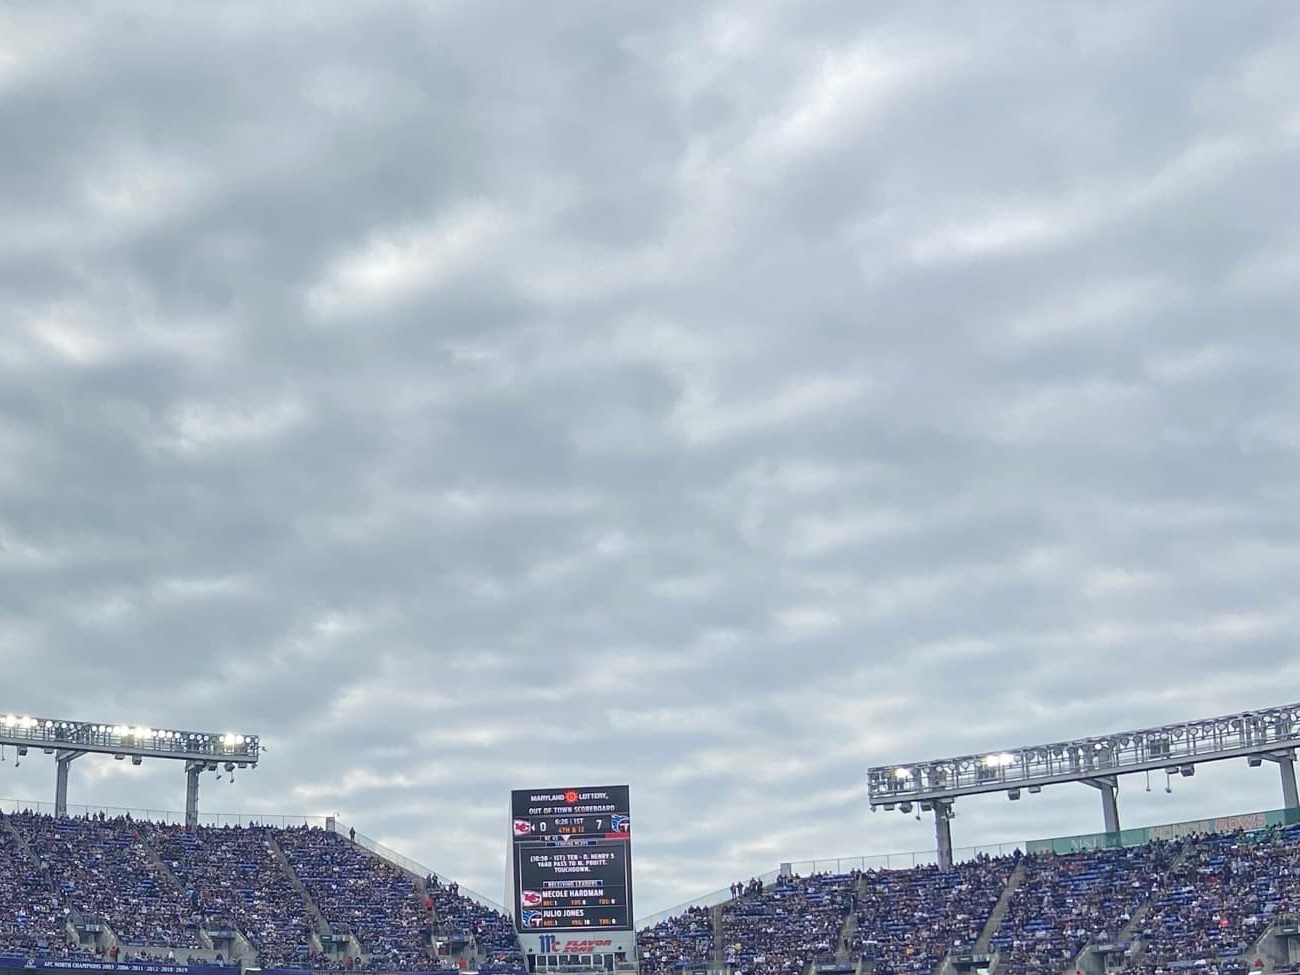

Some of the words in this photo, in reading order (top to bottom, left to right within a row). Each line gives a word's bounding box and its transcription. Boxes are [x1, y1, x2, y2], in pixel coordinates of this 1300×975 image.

[531, 794, 564, 802] MARYLAND
[574, 805, 615, 813] SCOREBOARD
[540, 822, 546, 832] 0
[596, 820, 602, 830] 7
[1215, 814, 1267, 831] ROWS
[543, 890, 568, 898] MECOLE
[570, 889, 604, 897] HARDMAN
[543, 910, 562, 918] JULIO
[563, 909, 584, 917] JONES
